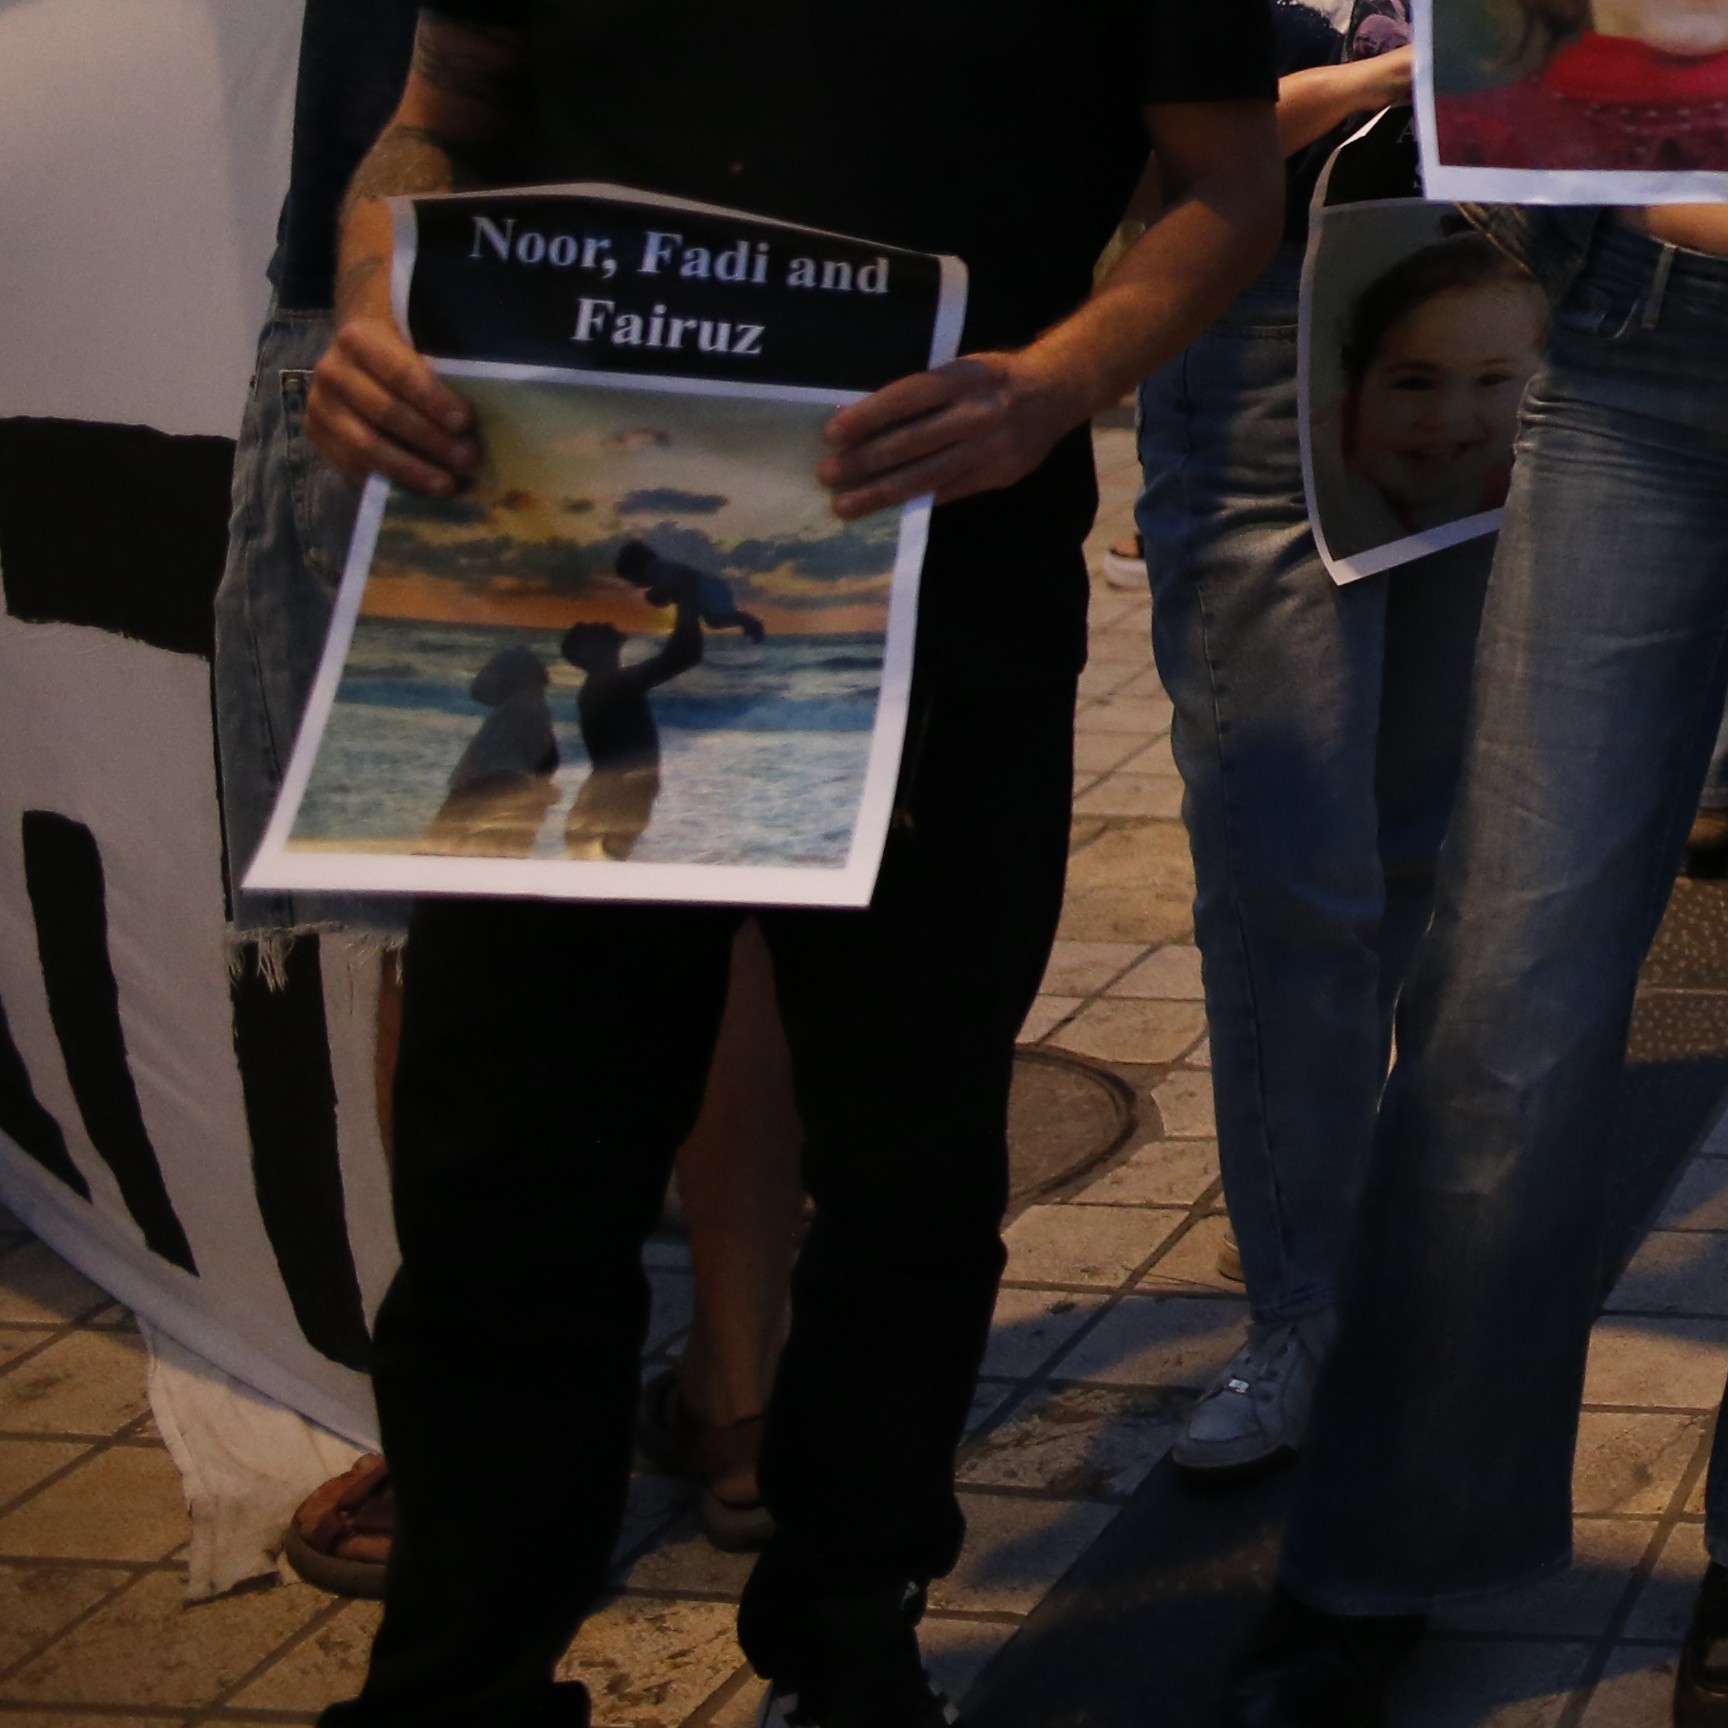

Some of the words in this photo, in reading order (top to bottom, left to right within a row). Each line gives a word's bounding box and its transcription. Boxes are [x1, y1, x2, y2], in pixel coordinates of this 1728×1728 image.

[470, 215, 617, 279] Noor,
[637, 231, 770, 284] Fadi
[787, 256, 890, 294] and
[570, 297, 767, 356] Fairuz
